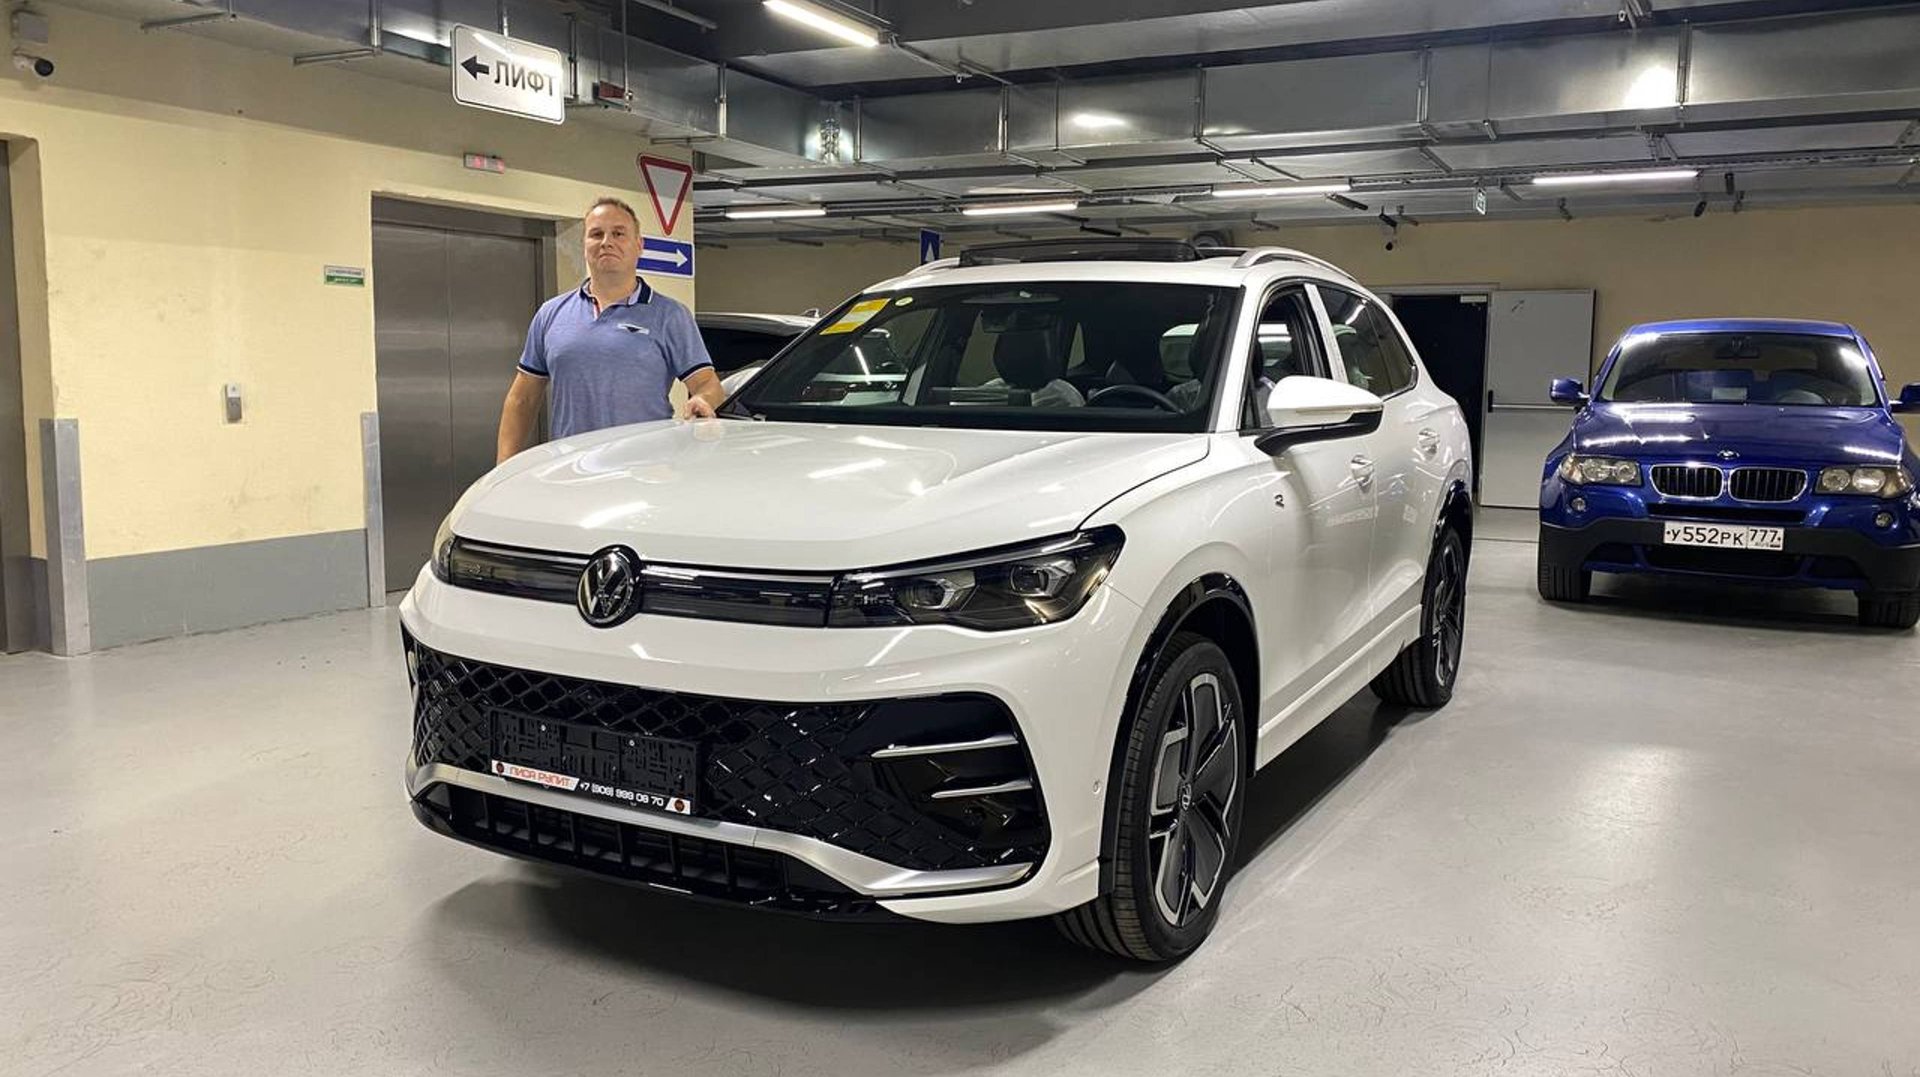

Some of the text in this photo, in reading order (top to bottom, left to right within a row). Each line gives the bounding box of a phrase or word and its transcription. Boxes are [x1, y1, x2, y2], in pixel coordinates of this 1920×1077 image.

[495, 61, 556, 96] ЛИФТ
[1671, 526, 1779, 546] У552РК 777
